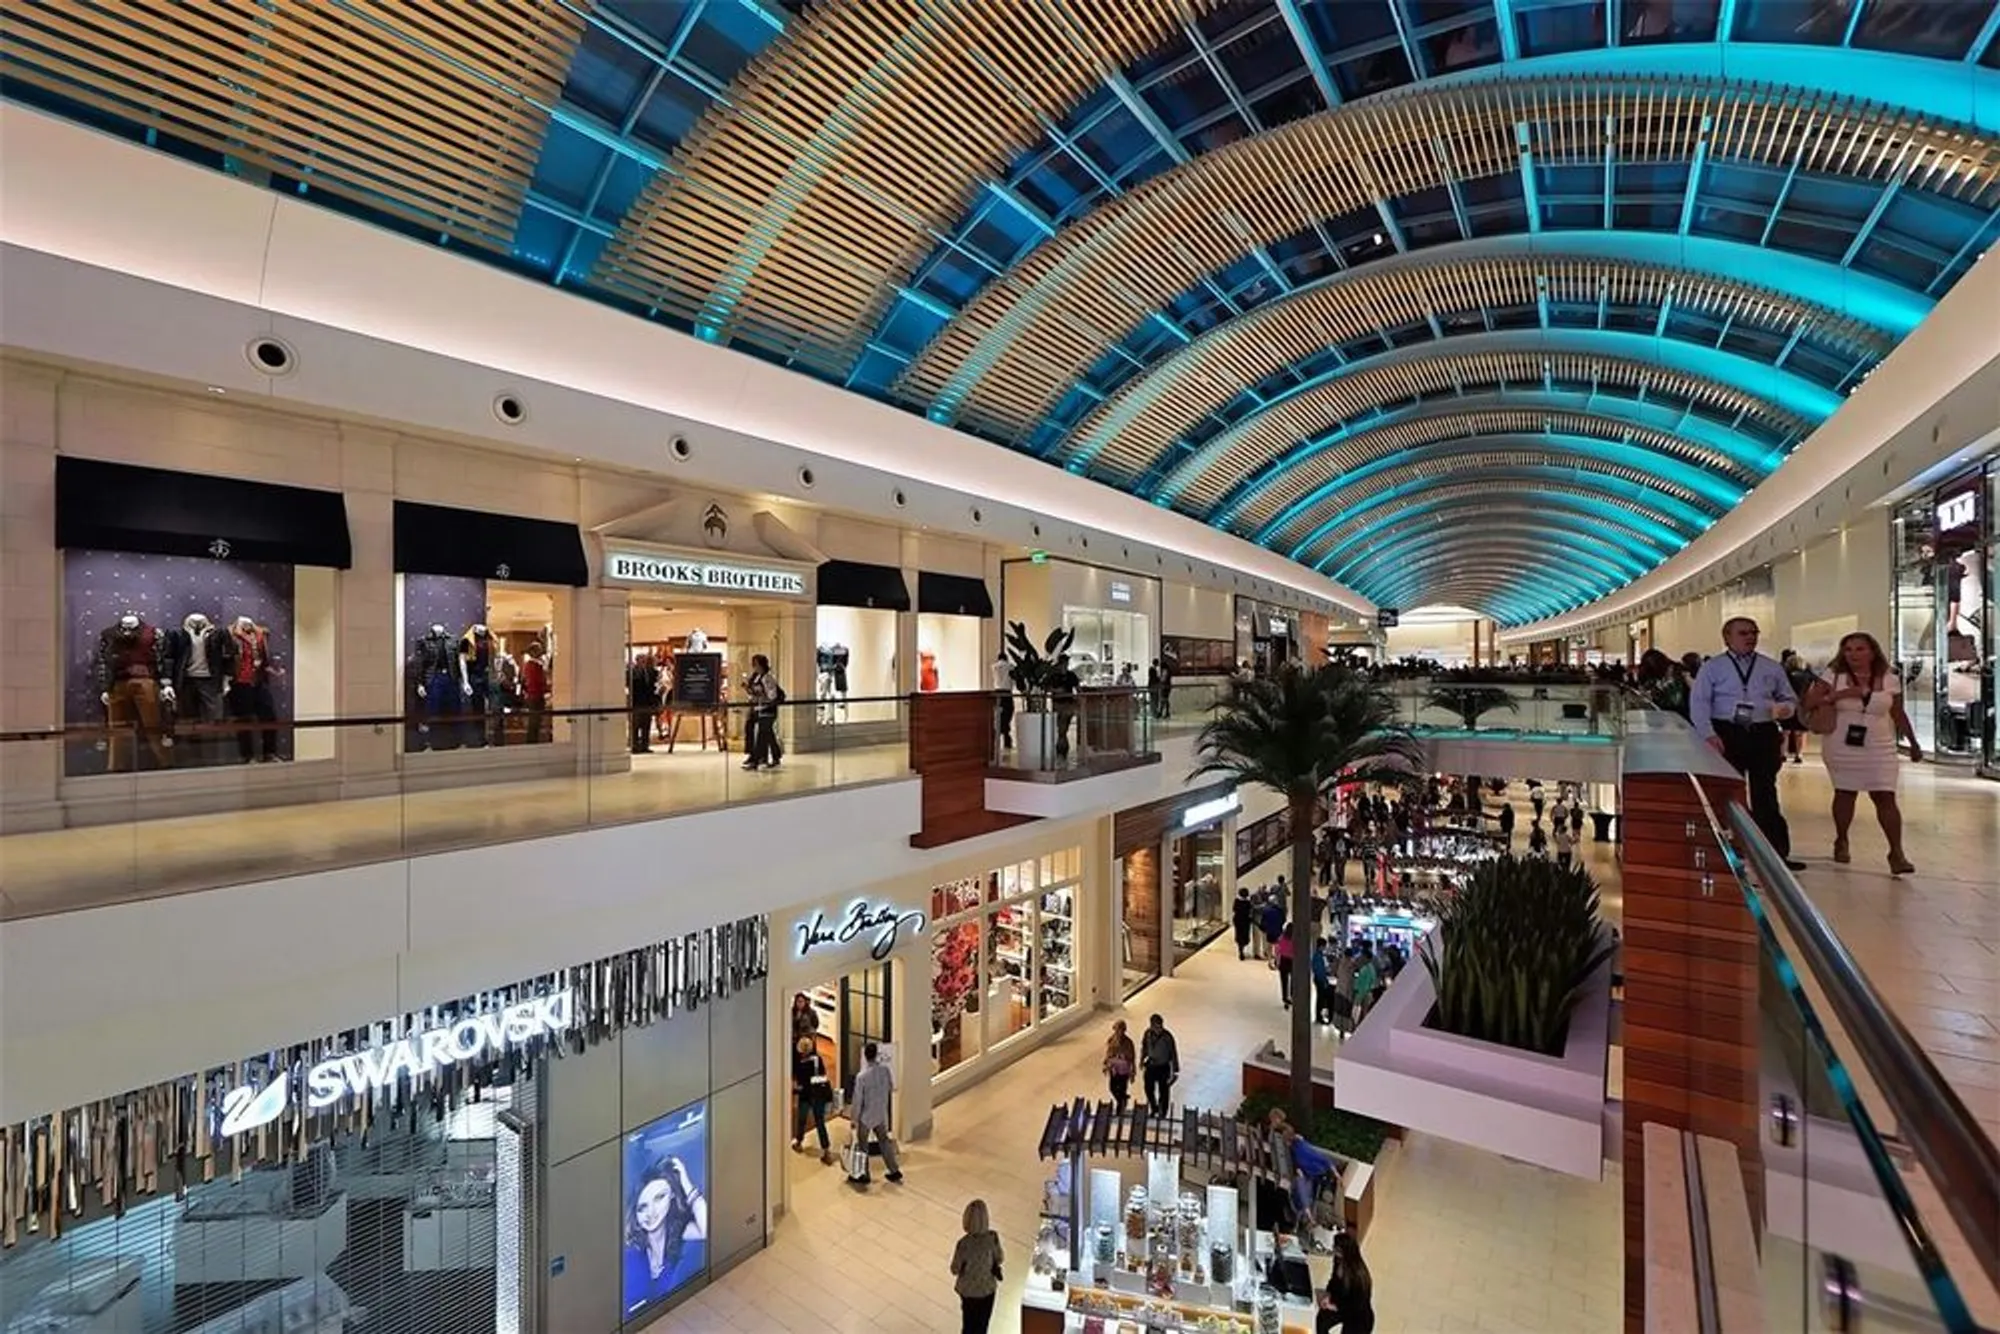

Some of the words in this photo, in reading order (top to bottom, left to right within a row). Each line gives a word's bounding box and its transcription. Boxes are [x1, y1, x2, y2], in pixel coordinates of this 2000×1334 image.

[617, 559, 702, 583] BROOKS
[707, 569, 804, 591] BROTHERS
[799, 913, 835, 955] Vera
[307, 986, 574, 1107] SWAROVSKI
